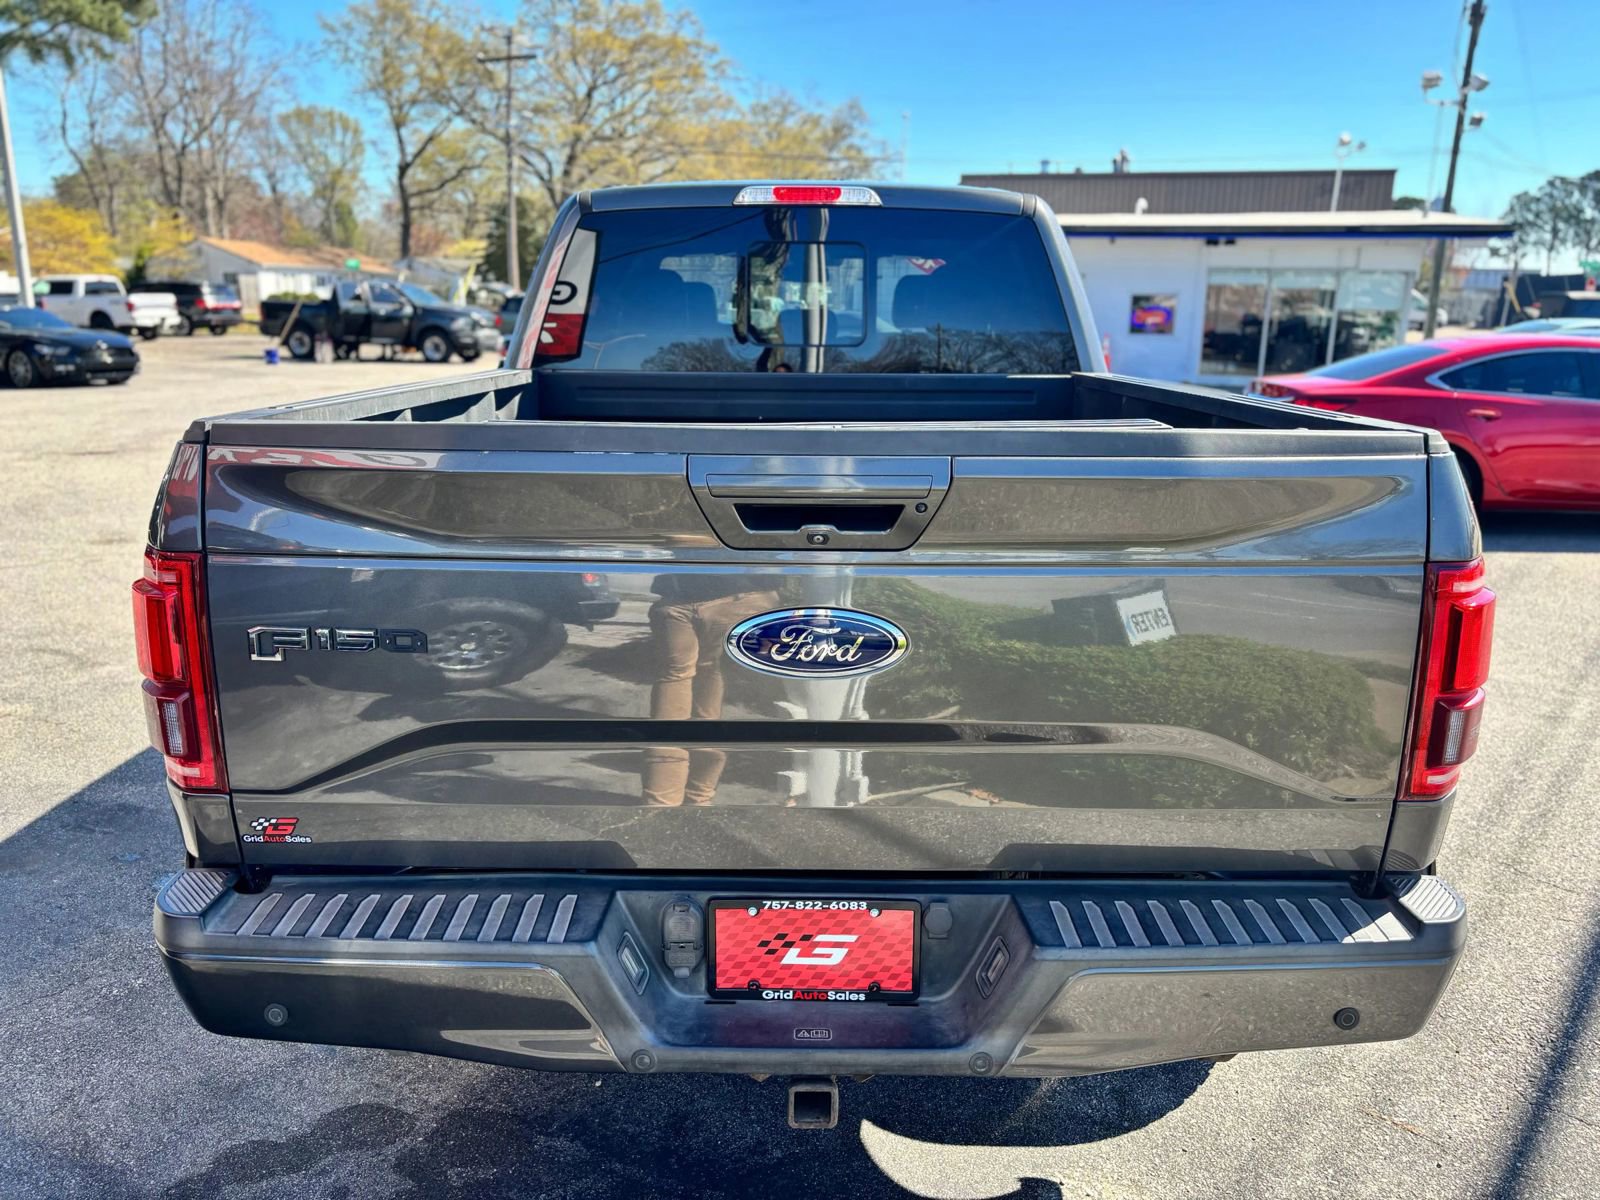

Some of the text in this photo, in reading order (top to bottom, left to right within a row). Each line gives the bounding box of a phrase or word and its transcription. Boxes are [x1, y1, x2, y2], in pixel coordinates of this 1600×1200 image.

[770, 624, 865, 662] Ford
[243, 835, 312, 843] GridAutoSales
[762, 901, 868, 910] 757-822-6083
[762, 990, 866, 1001] GridAutoSales
